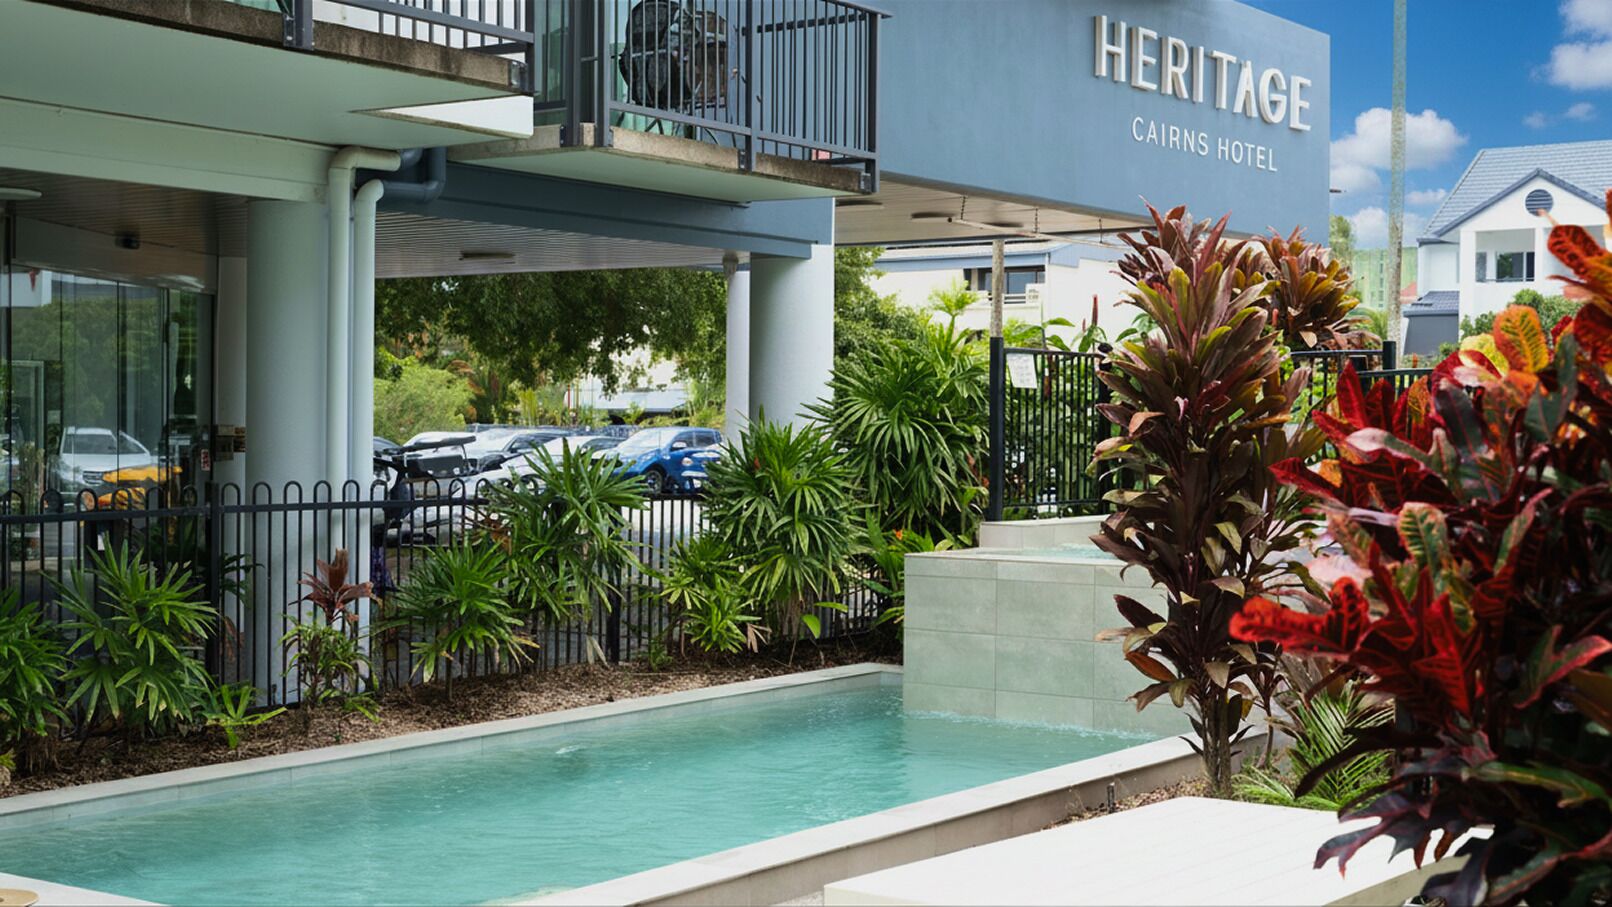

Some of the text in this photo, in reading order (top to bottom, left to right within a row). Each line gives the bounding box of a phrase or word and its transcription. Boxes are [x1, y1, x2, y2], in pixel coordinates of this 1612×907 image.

[1093, 15, 1312, 131] HERITAGE
[1131, 116, 1278, 172] CAIRNS HOTEL
